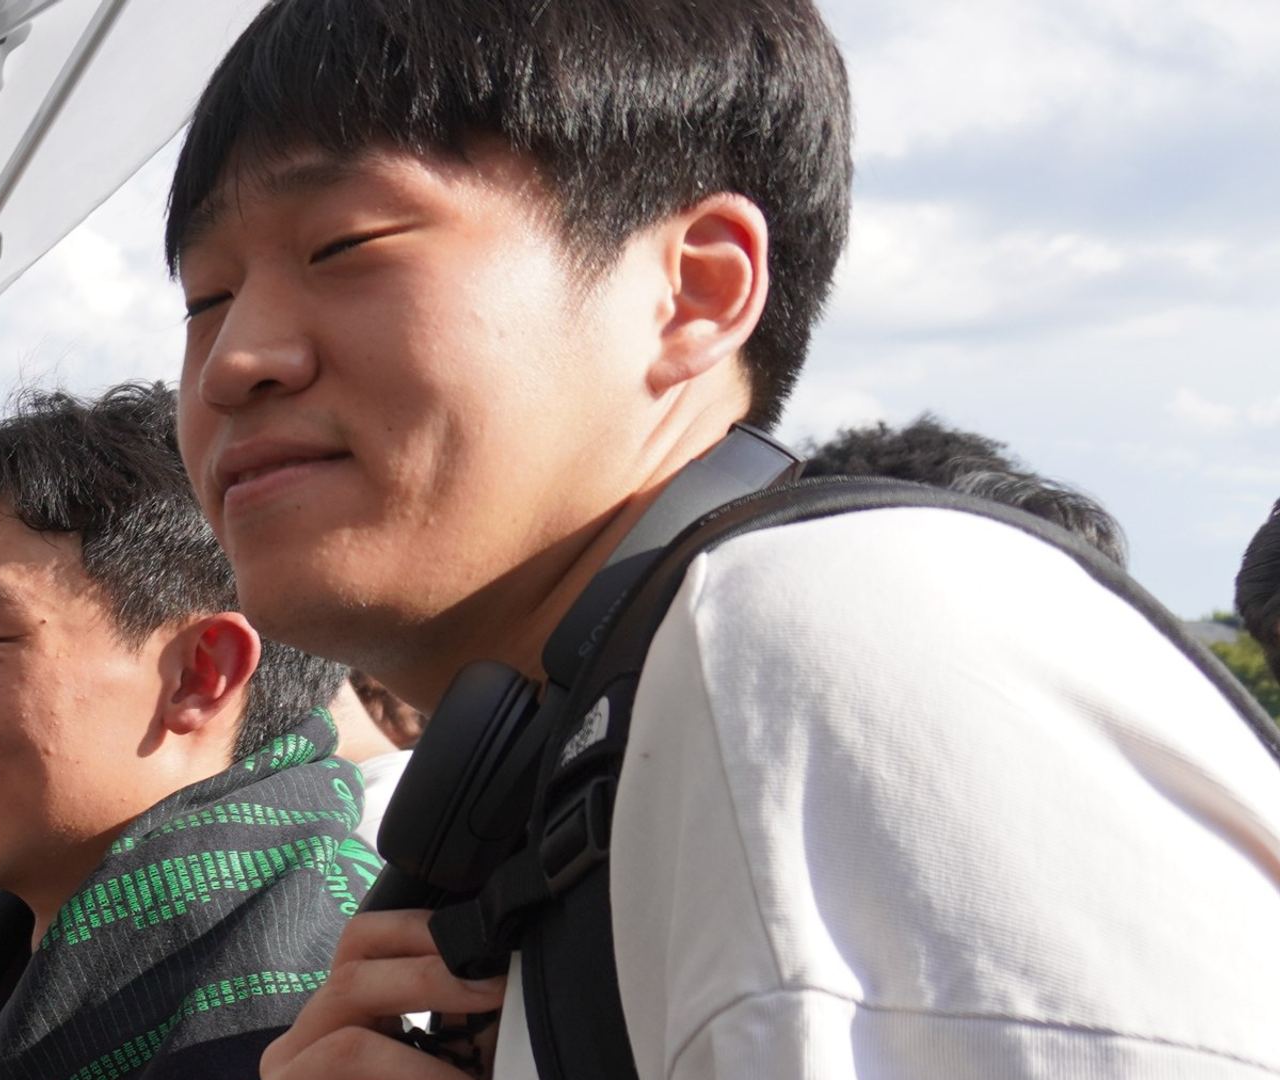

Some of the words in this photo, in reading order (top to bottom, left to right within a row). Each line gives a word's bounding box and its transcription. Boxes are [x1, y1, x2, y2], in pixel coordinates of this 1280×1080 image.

[117, 905, 127, 918] AUS
[161, 906, 172, 919] AUS
[175, 901, 186, 914] AUS
[90, 914, 100, 927] AUS
[103, 909, 114, 923] AUS
[135, 916, 145, 929] AUS
[148, 911, 158, 924] AUS
[79, 926, 91, 940] AUS
